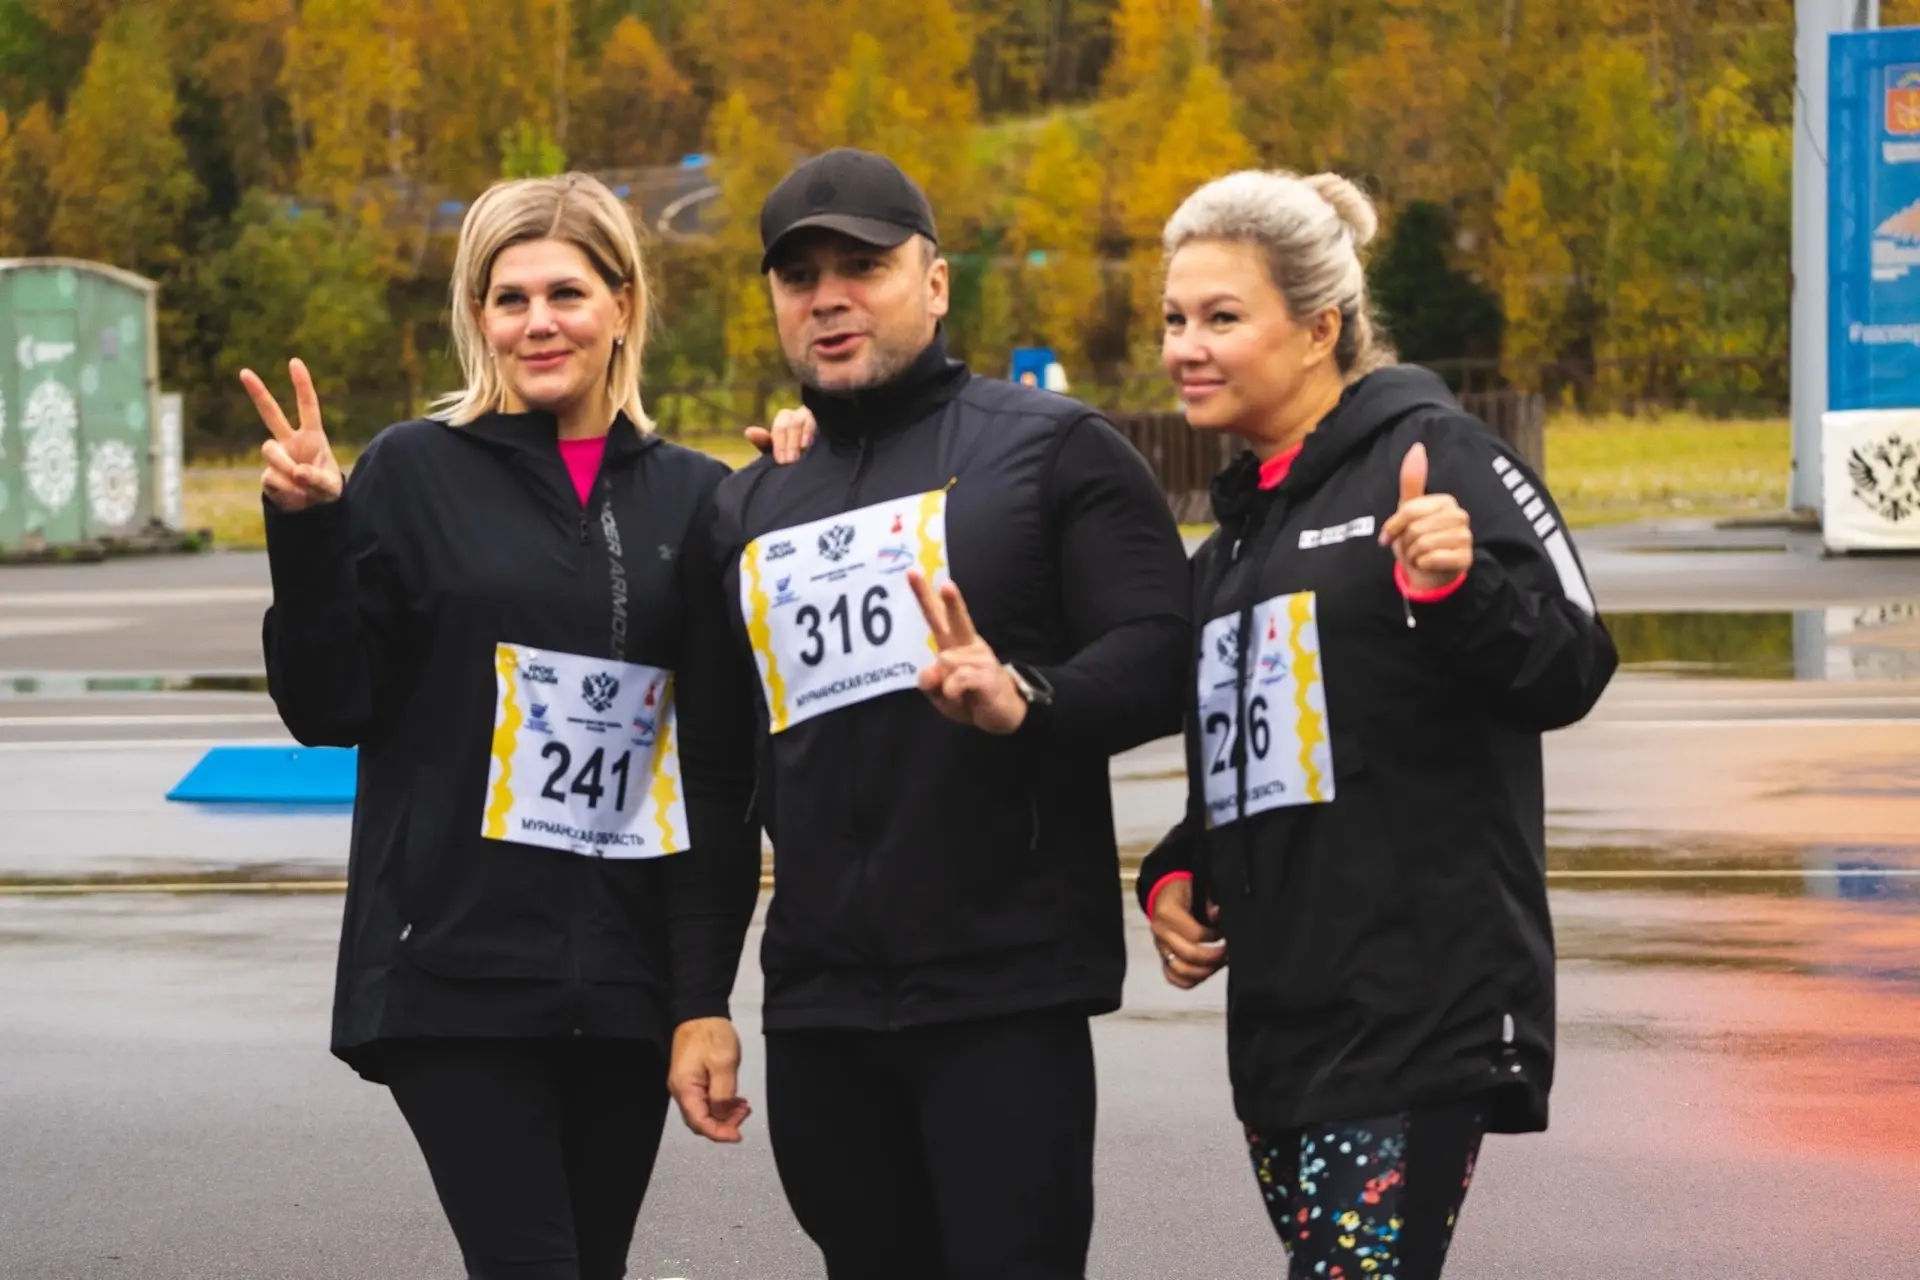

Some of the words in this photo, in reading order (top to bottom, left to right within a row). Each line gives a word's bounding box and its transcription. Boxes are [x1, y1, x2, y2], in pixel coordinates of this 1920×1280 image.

[608, 556, 628, 661] ARMOU
[796, 585, 892, 667] 316
[796, 675, 863, 707] МУРМАНСКАЯ
[863, 662, 917, 686] ОБЛАСТЬ
[1206, 695, 1270, 776] 26
[541, 741, 632, 812] 241
[521, 817, 595, 843] МУРМАНСКАЯ
